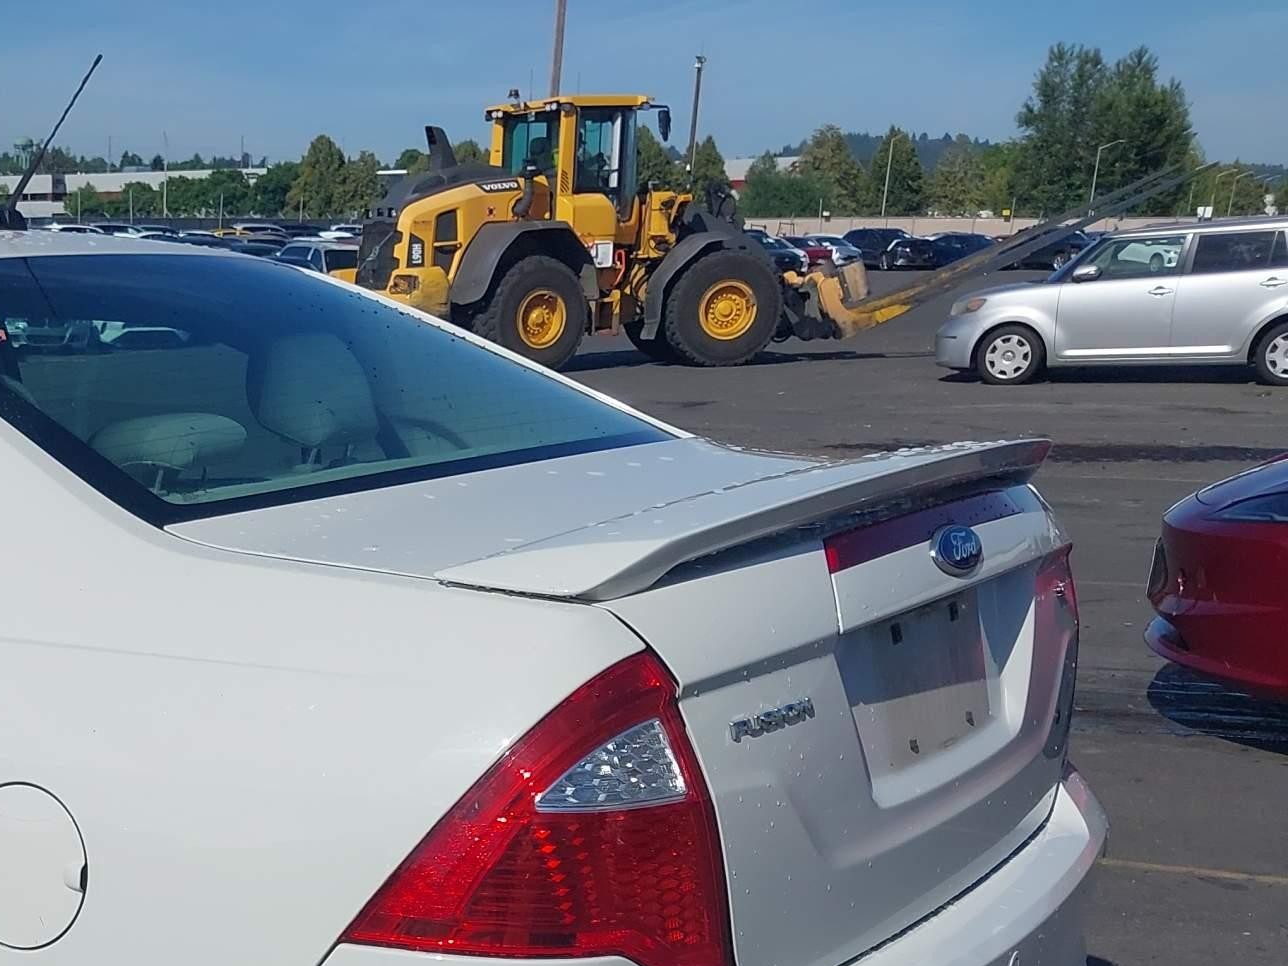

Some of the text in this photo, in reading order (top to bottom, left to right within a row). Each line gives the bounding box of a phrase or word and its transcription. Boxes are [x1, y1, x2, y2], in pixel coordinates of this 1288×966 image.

[482, 181, 518, 191] VOLVO
[412, 243, 422, 264] L90H
[950, 531, 977, 561] Ford
[729, 697, 816, 743] FUSION
